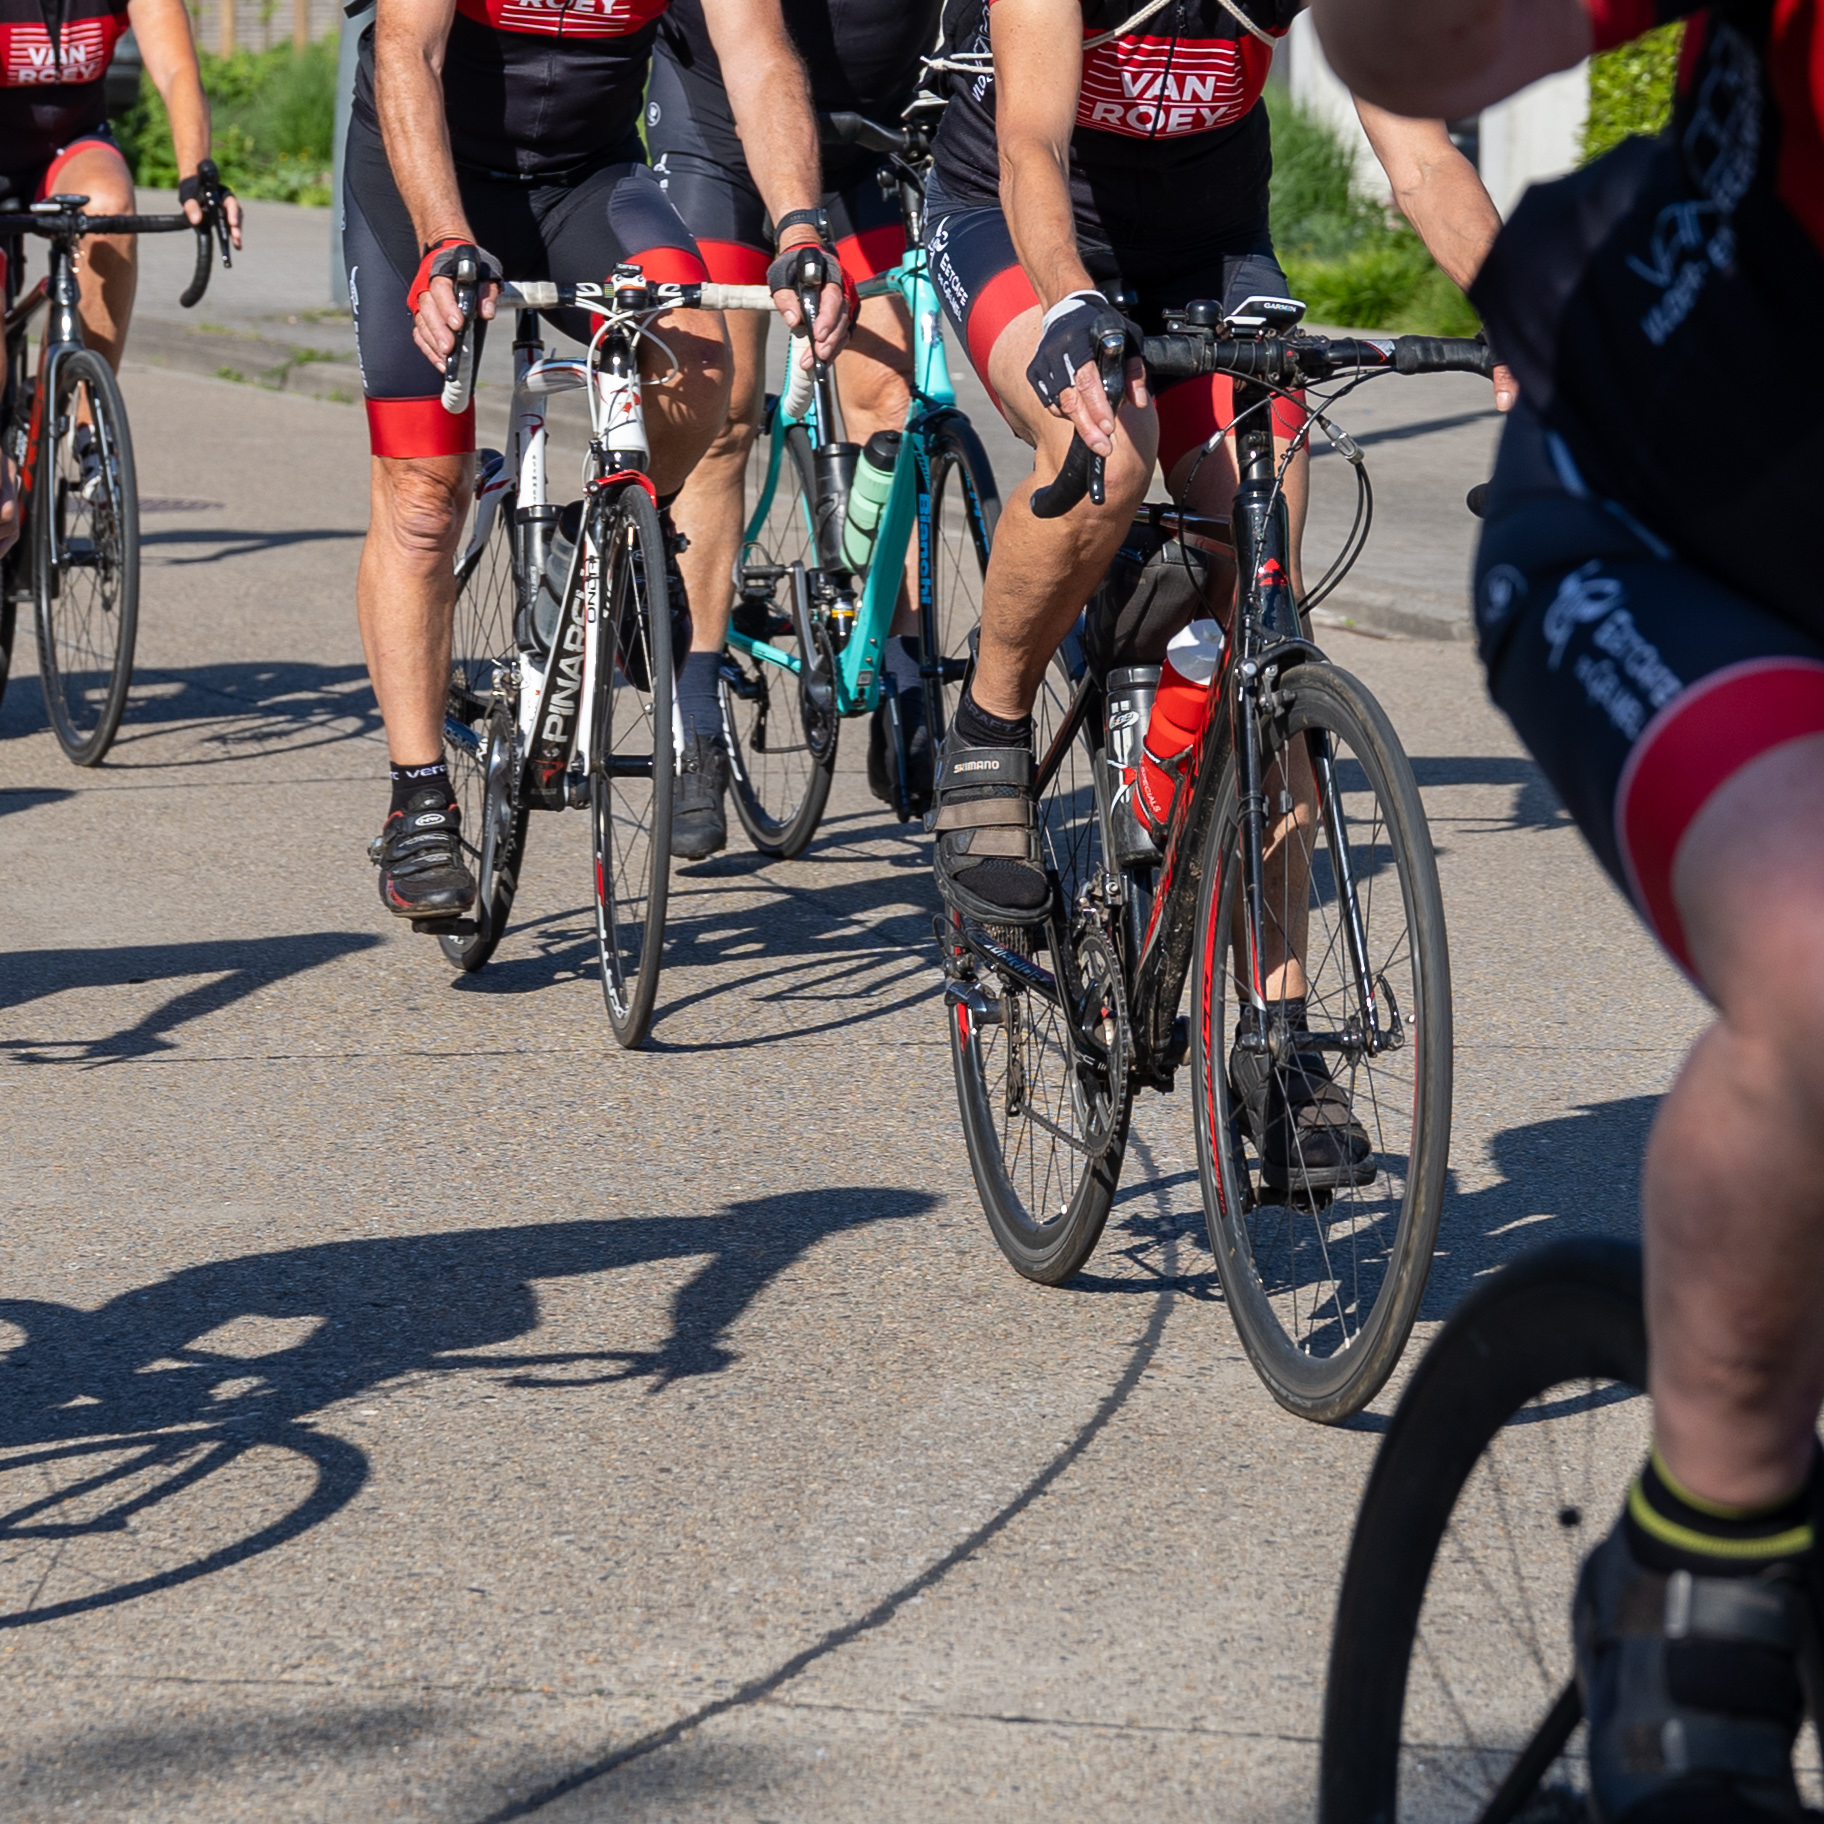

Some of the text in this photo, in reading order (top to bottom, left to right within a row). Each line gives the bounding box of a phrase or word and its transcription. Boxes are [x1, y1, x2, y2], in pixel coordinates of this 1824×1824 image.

[27, 45, 87, 67] VAN
[1120, 71, 1217, 103] VAN
[1091, 102, 1230, 134] ROEY
[919, 493, 932, 604] Bianchi
[952, 760, 1000, 774] SHIMANO
